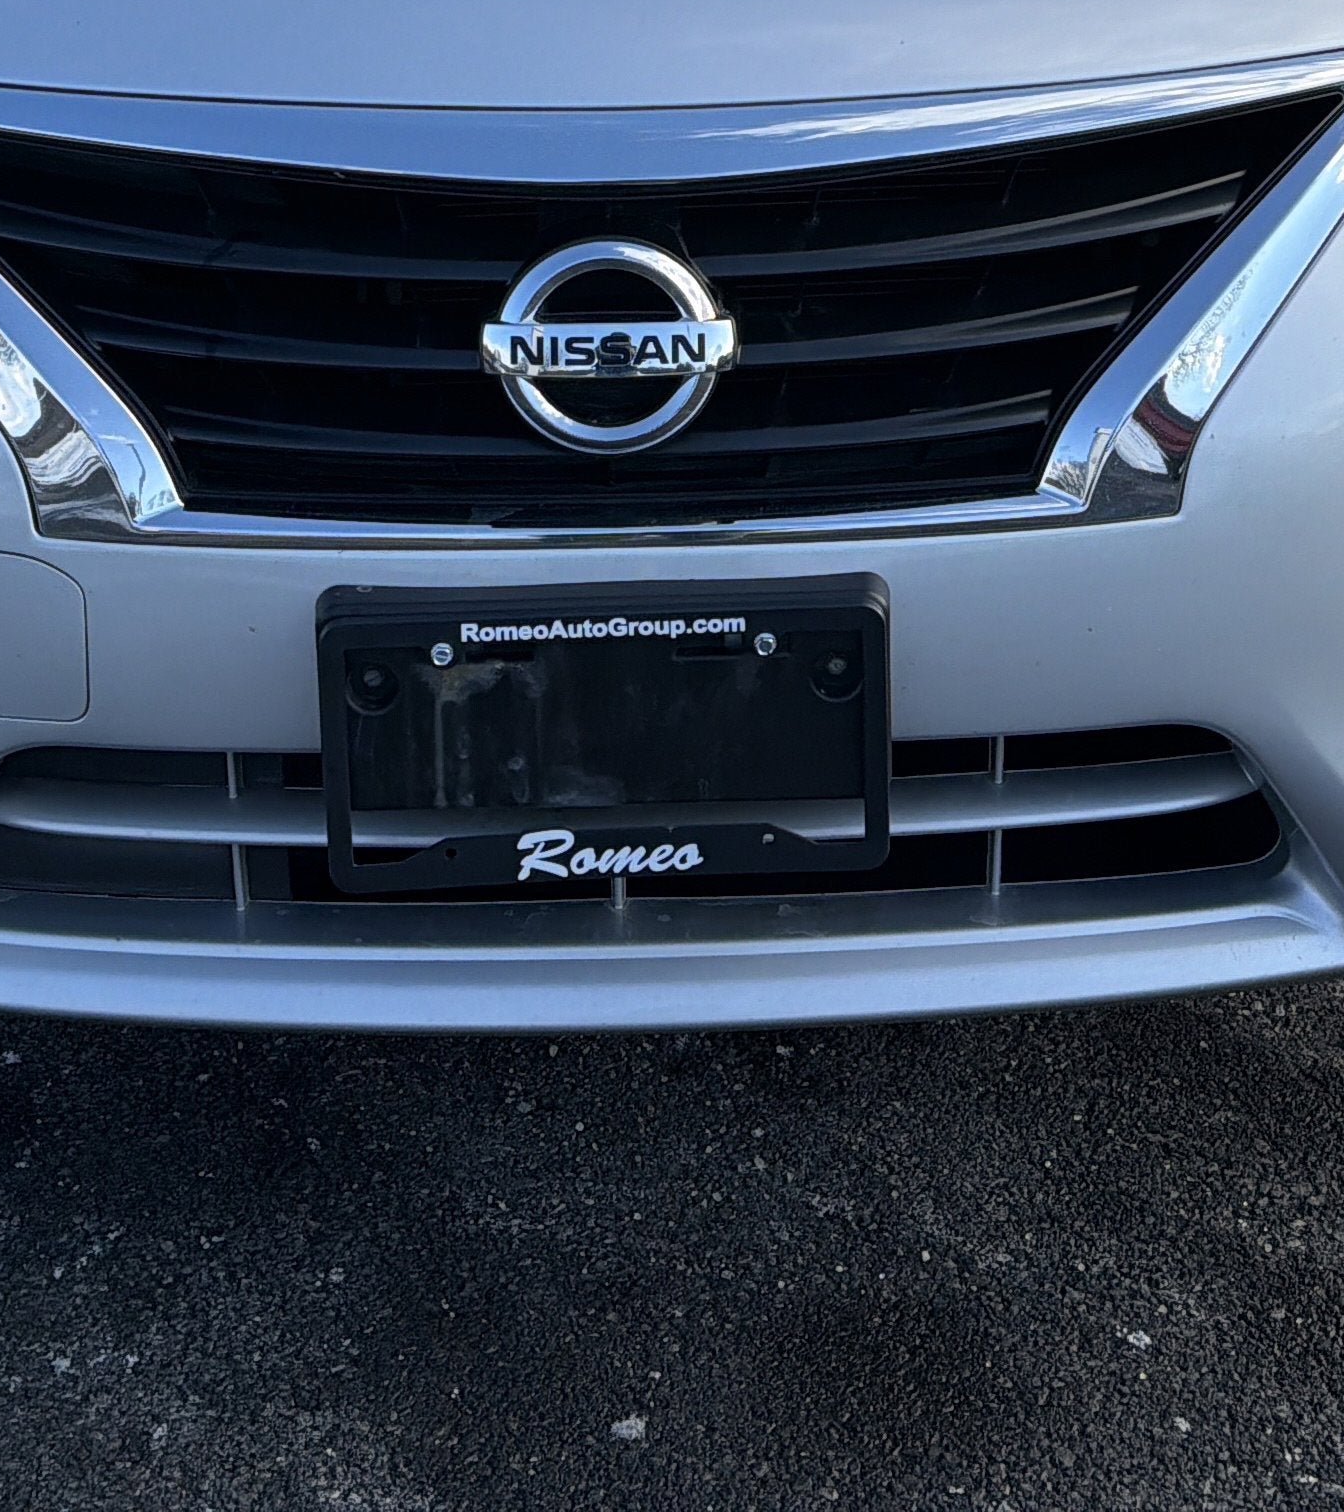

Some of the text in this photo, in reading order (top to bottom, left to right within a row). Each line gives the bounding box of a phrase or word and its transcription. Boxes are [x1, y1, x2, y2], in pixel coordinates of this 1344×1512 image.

[510, 333, 706, 367] NISSAN
[460, 617, 746, 643] RomeoAutoGroup.com
[517, 829, 703, 881] Romeo
